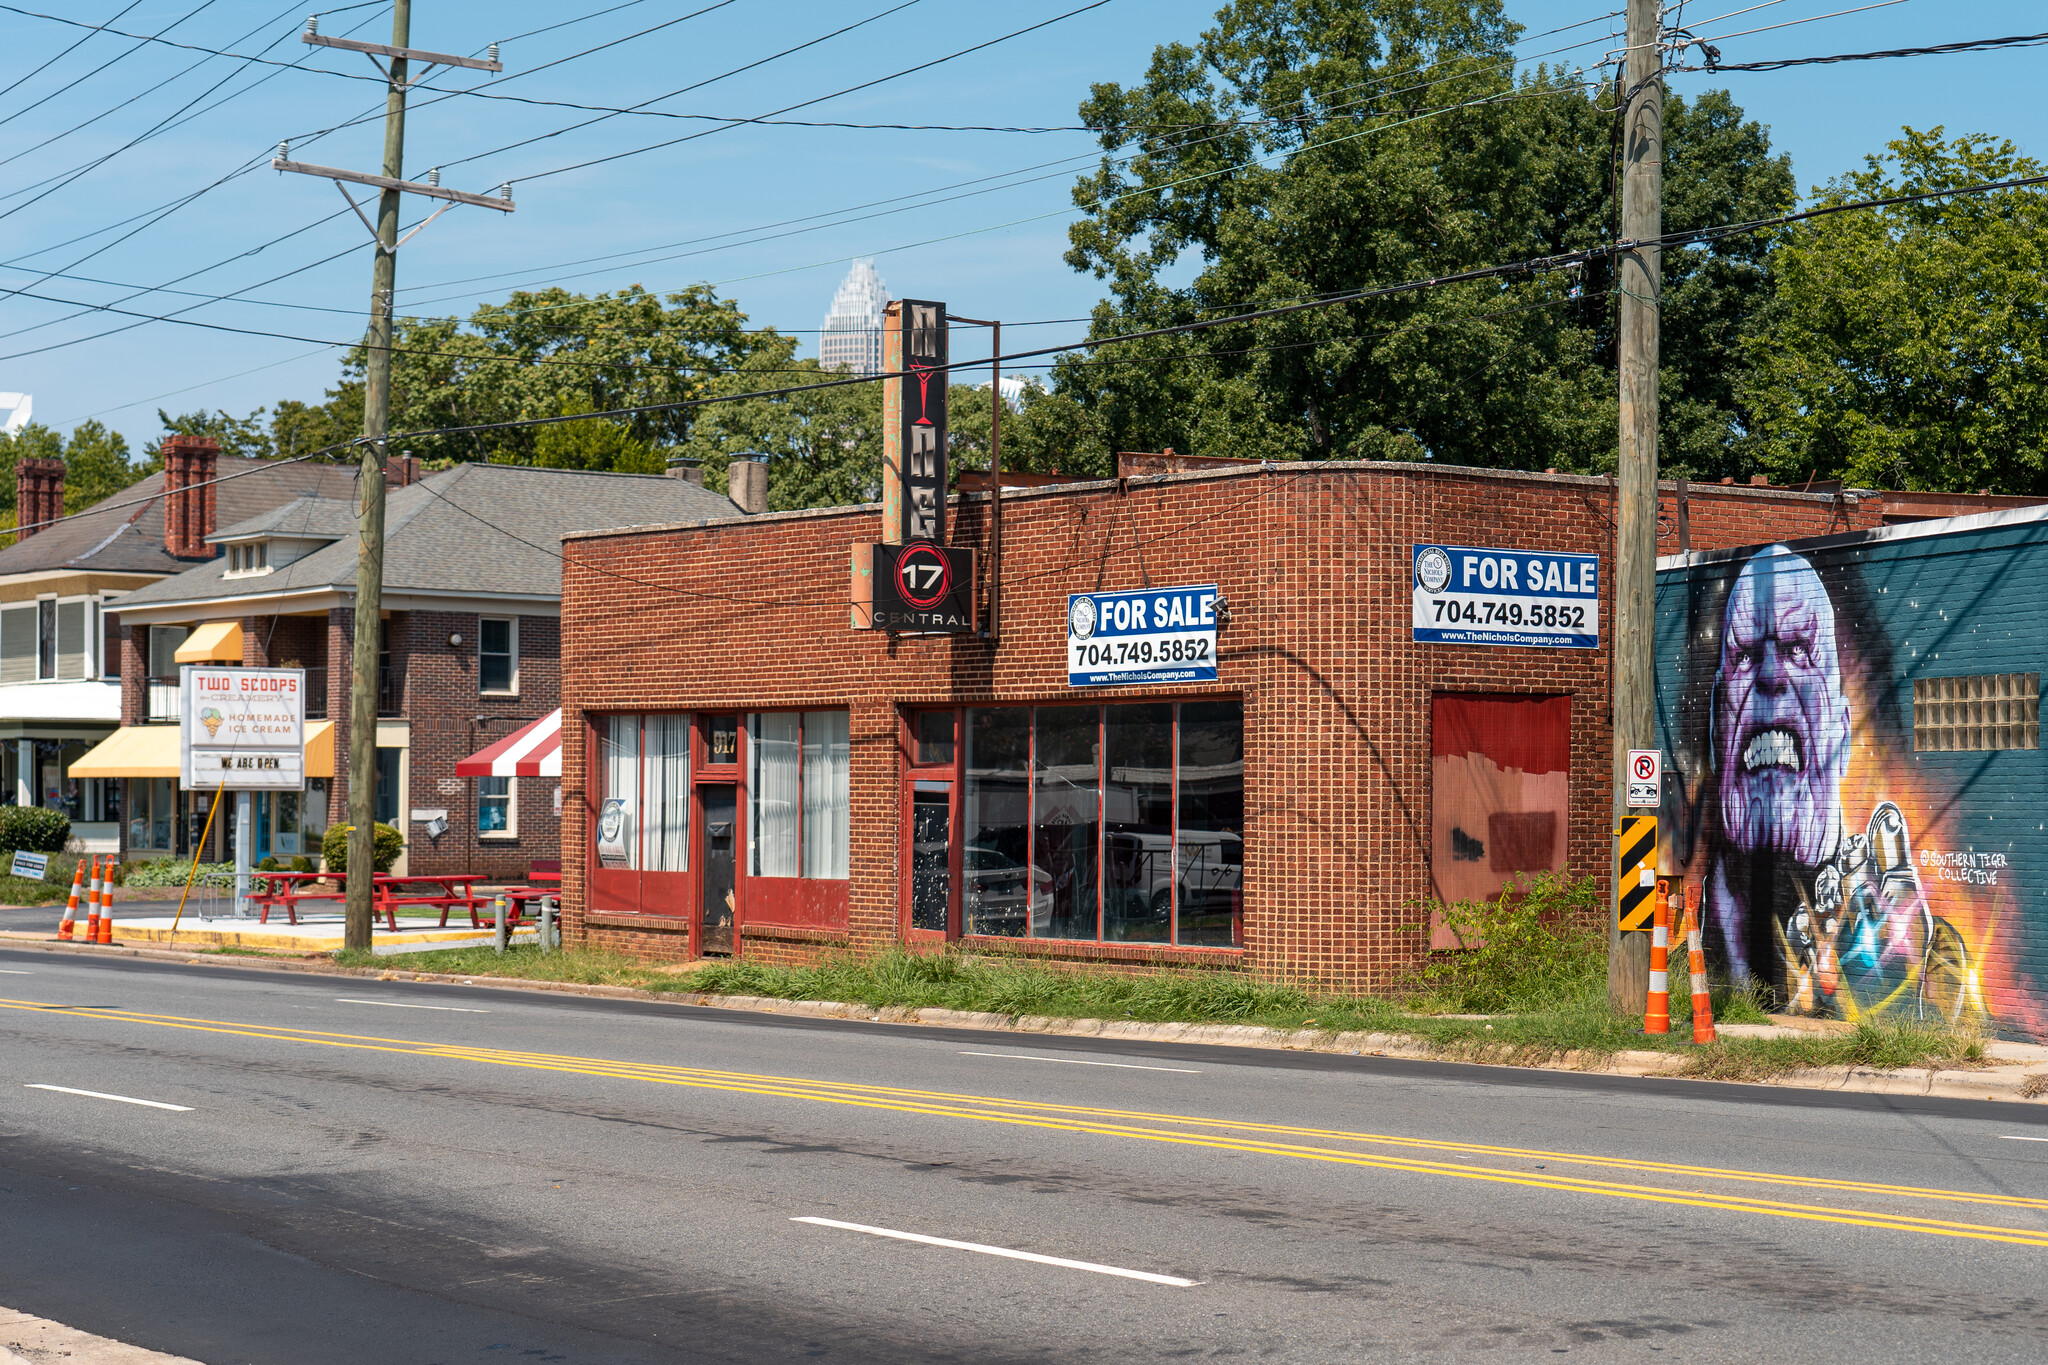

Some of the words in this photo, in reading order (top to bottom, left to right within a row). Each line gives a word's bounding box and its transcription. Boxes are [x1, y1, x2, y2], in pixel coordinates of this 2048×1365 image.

[902, 564, 944, 589] 17
[1463, 556, 1519, 590] FOR
[1526, 560, 1596, 593] SALE
[873, 612, 971, 626] CENTRAL
[1100, 599, 1147, 632] FOR
[1153, 594, 1215, 628] SALE
[1432, 599, 1585, 628] 704.749.5852
[1441, 631, 1573, 646] www.TheNicholsCompany.com
[1076, 638, 1209, 666] 704.749.5852
[198, 677, 230, 691] TWO
[241, 678, 297, 692] SCOOPS
[1089, 669, 1196, 683] www.TheNicholsCompany.com
[210, 693, 284, 702] CREAMERY
[229, 713, 296, 722] HOMEMADE
[229, 725, 247, 733] ICE
[252, 725, 291, 733] CREAM
[713, 730, 737, 754] 917
[221, 757, 233, 769] WE
[257, 757, 280, 769] OPEN
[1920, 849, 1976, 868] @SOUTHERN
[1976, 853, 2008, 869] TIGER
[1938, 867, 1998, 886] COLLECTIVE
